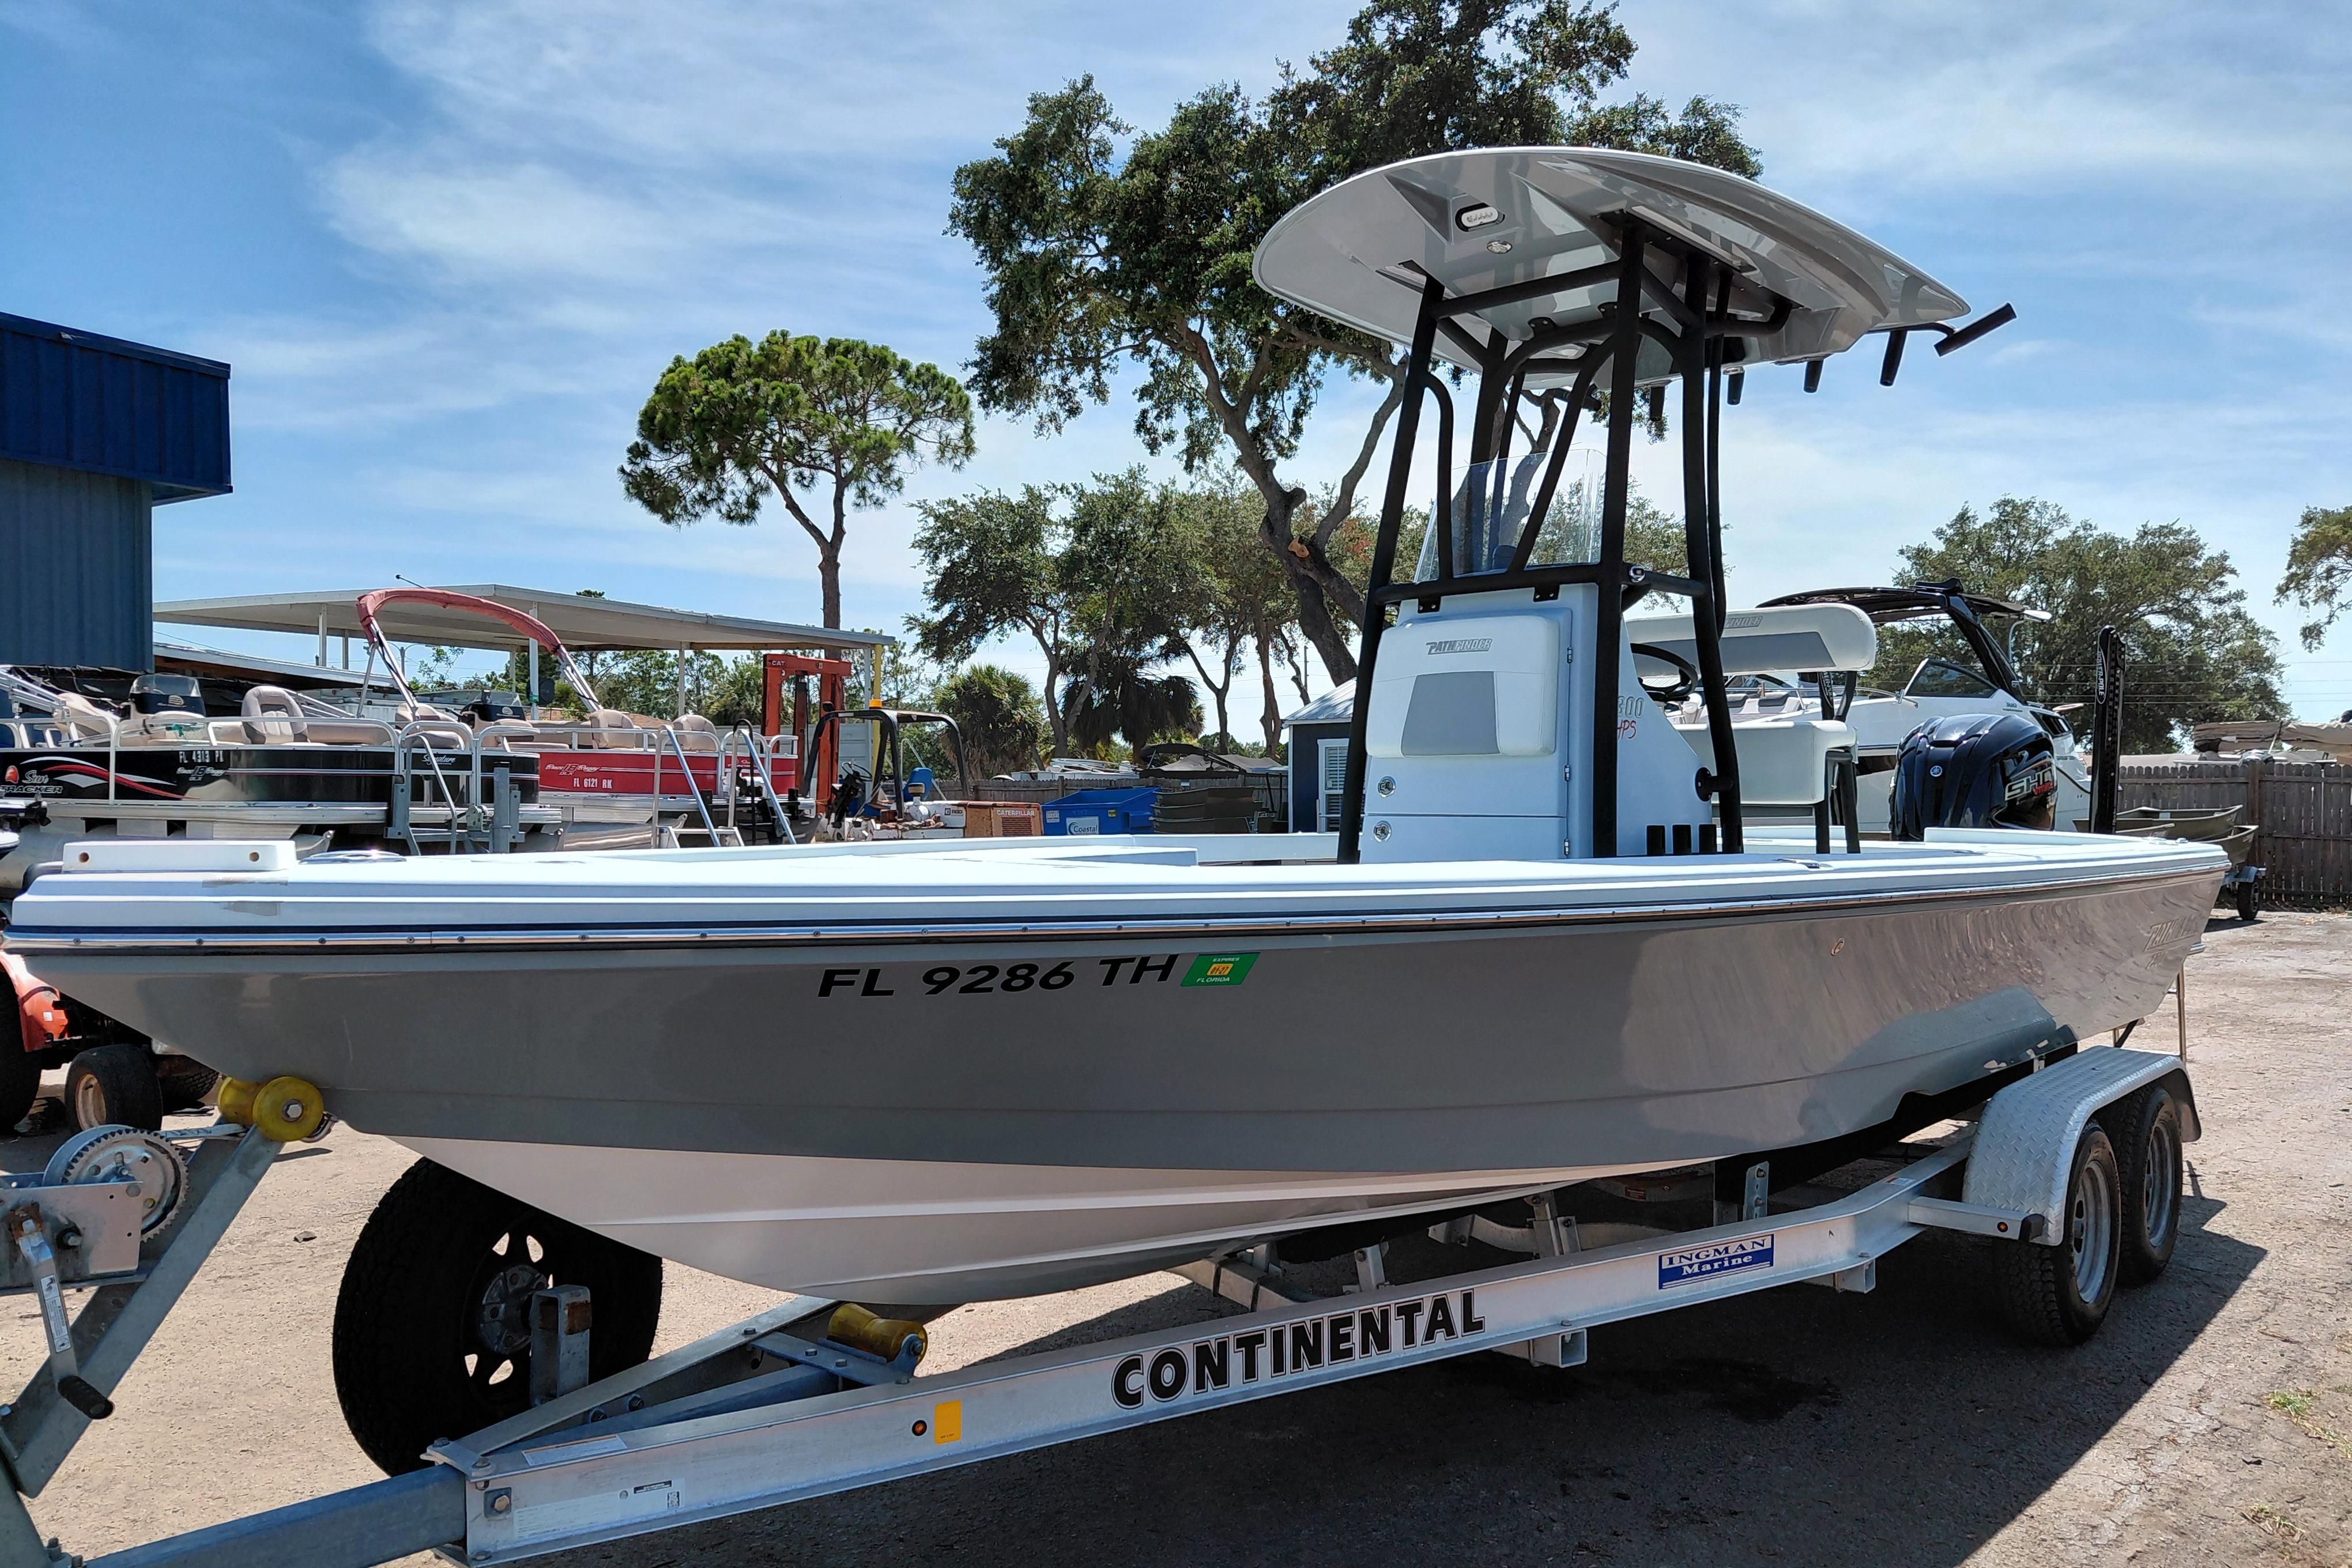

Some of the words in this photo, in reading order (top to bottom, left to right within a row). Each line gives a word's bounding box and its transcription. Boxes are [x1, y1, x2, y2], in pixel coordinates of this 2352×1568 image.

[1425, 638, 1493, 655] PATHFINDER
[179, 751, 189, 763] FL
[0, 785, 63, 794] TRACKER
[573, 778, 581, 787] FL
[583, 778, 598, 788] 6121
[602, 779, 612, 789] RK
[1073, 825, 1098, 833] Coastal
[817, 968, 895, 998] FL
[922, 960, 1075, 996] 9286
[1098, 953, 1179, 987] TH
[1210, 967, 1229, 975] 01-27
[1666, 1239, 1767, 1266] INGMAN
[1681, 1254, 1753, 1276] Marine
[1111, 1288, 1486, 1409] CONTINENTAL
